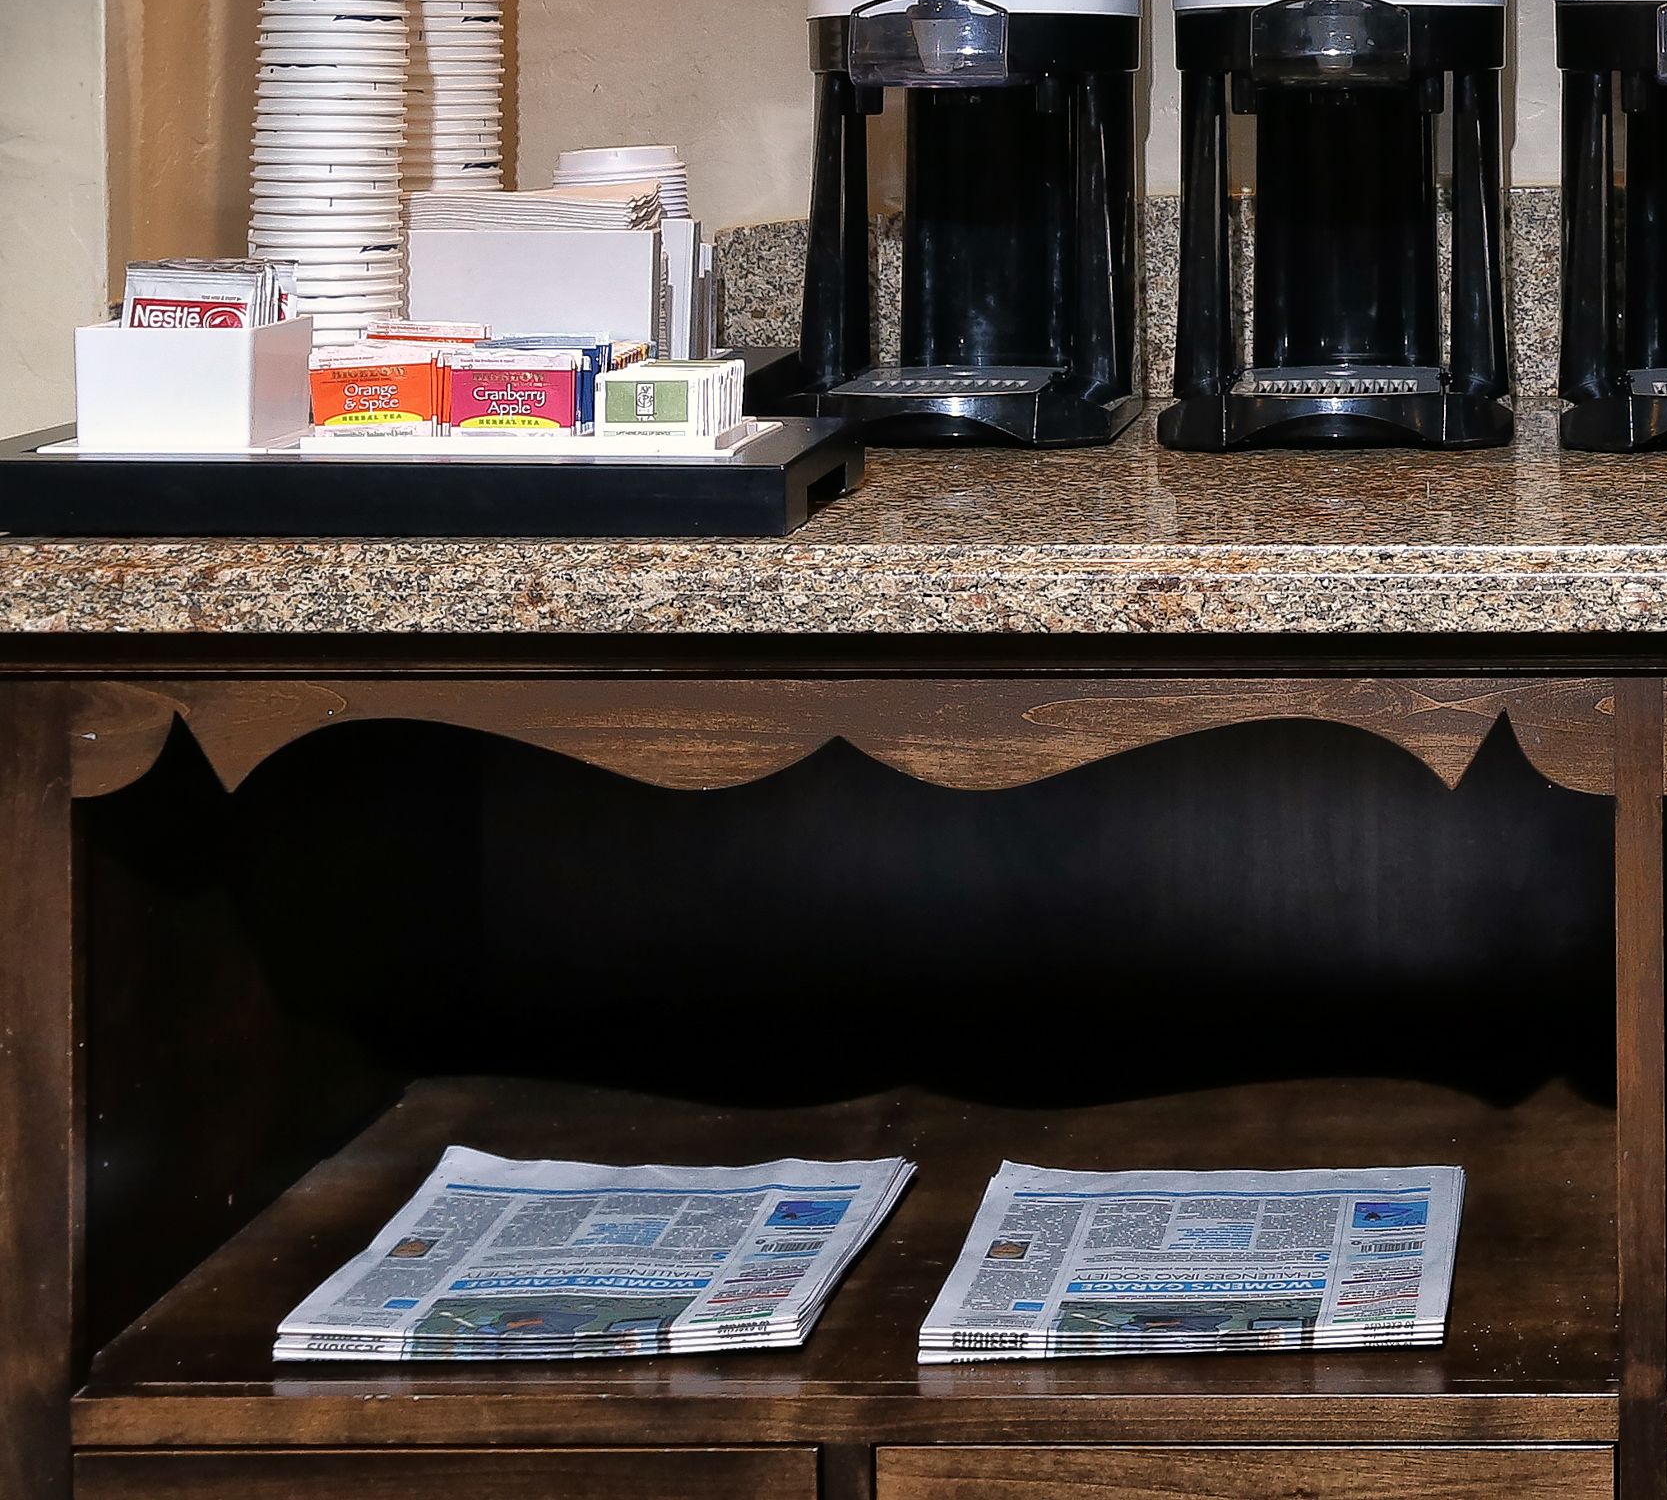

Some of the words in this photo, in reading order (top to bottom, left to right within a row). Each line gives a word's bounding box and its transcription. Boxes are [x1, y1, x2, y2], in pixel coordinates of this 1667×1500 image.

[343, 382, 399, 400] Orange
[472, 383, 546, 407] Cranberry
[343, 397, 357, 411] &
[358, 396, 400, 412] Spice
[487, 399, 532, 418] Apple
[341, 414, 380, 422] HERBAL
[478, 418, 517, 426] HERBAL
[521, 418, 540, 426] TEA
[1072, 1272, 1152, 1281] SOCIETY
[1155, 1272, 1201, 1281] IRAQ
[1204, 1270, 1327, 1281] CHALLENGES
[1081, 1282, 1185, 1292] GARAGE
[1191, 1280, 1314, 1291] WOMEN'S
